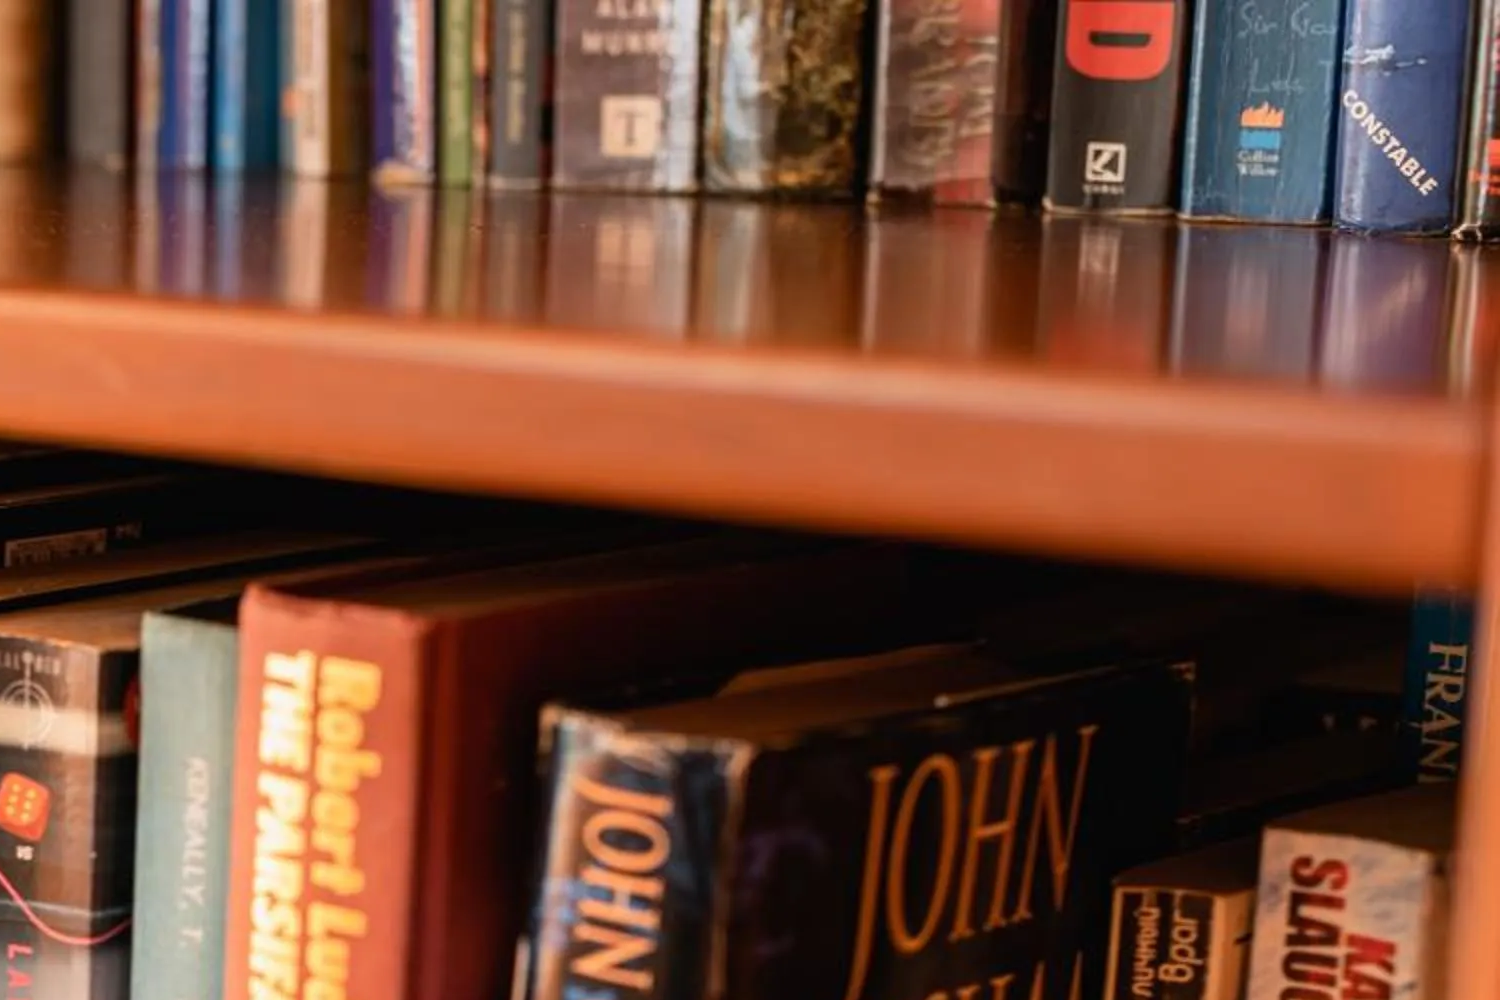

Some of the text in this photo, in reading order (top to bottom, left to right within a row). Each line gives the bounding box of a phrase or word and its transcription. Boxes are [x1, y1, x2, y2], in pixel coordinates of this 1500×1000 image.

[1343, 89, 1440, 197] CONSTABLE
[257, 649, 317, 771] THE
[310, 655, 382, 895] Robert
[568, 775, 675, 993] JOHN
